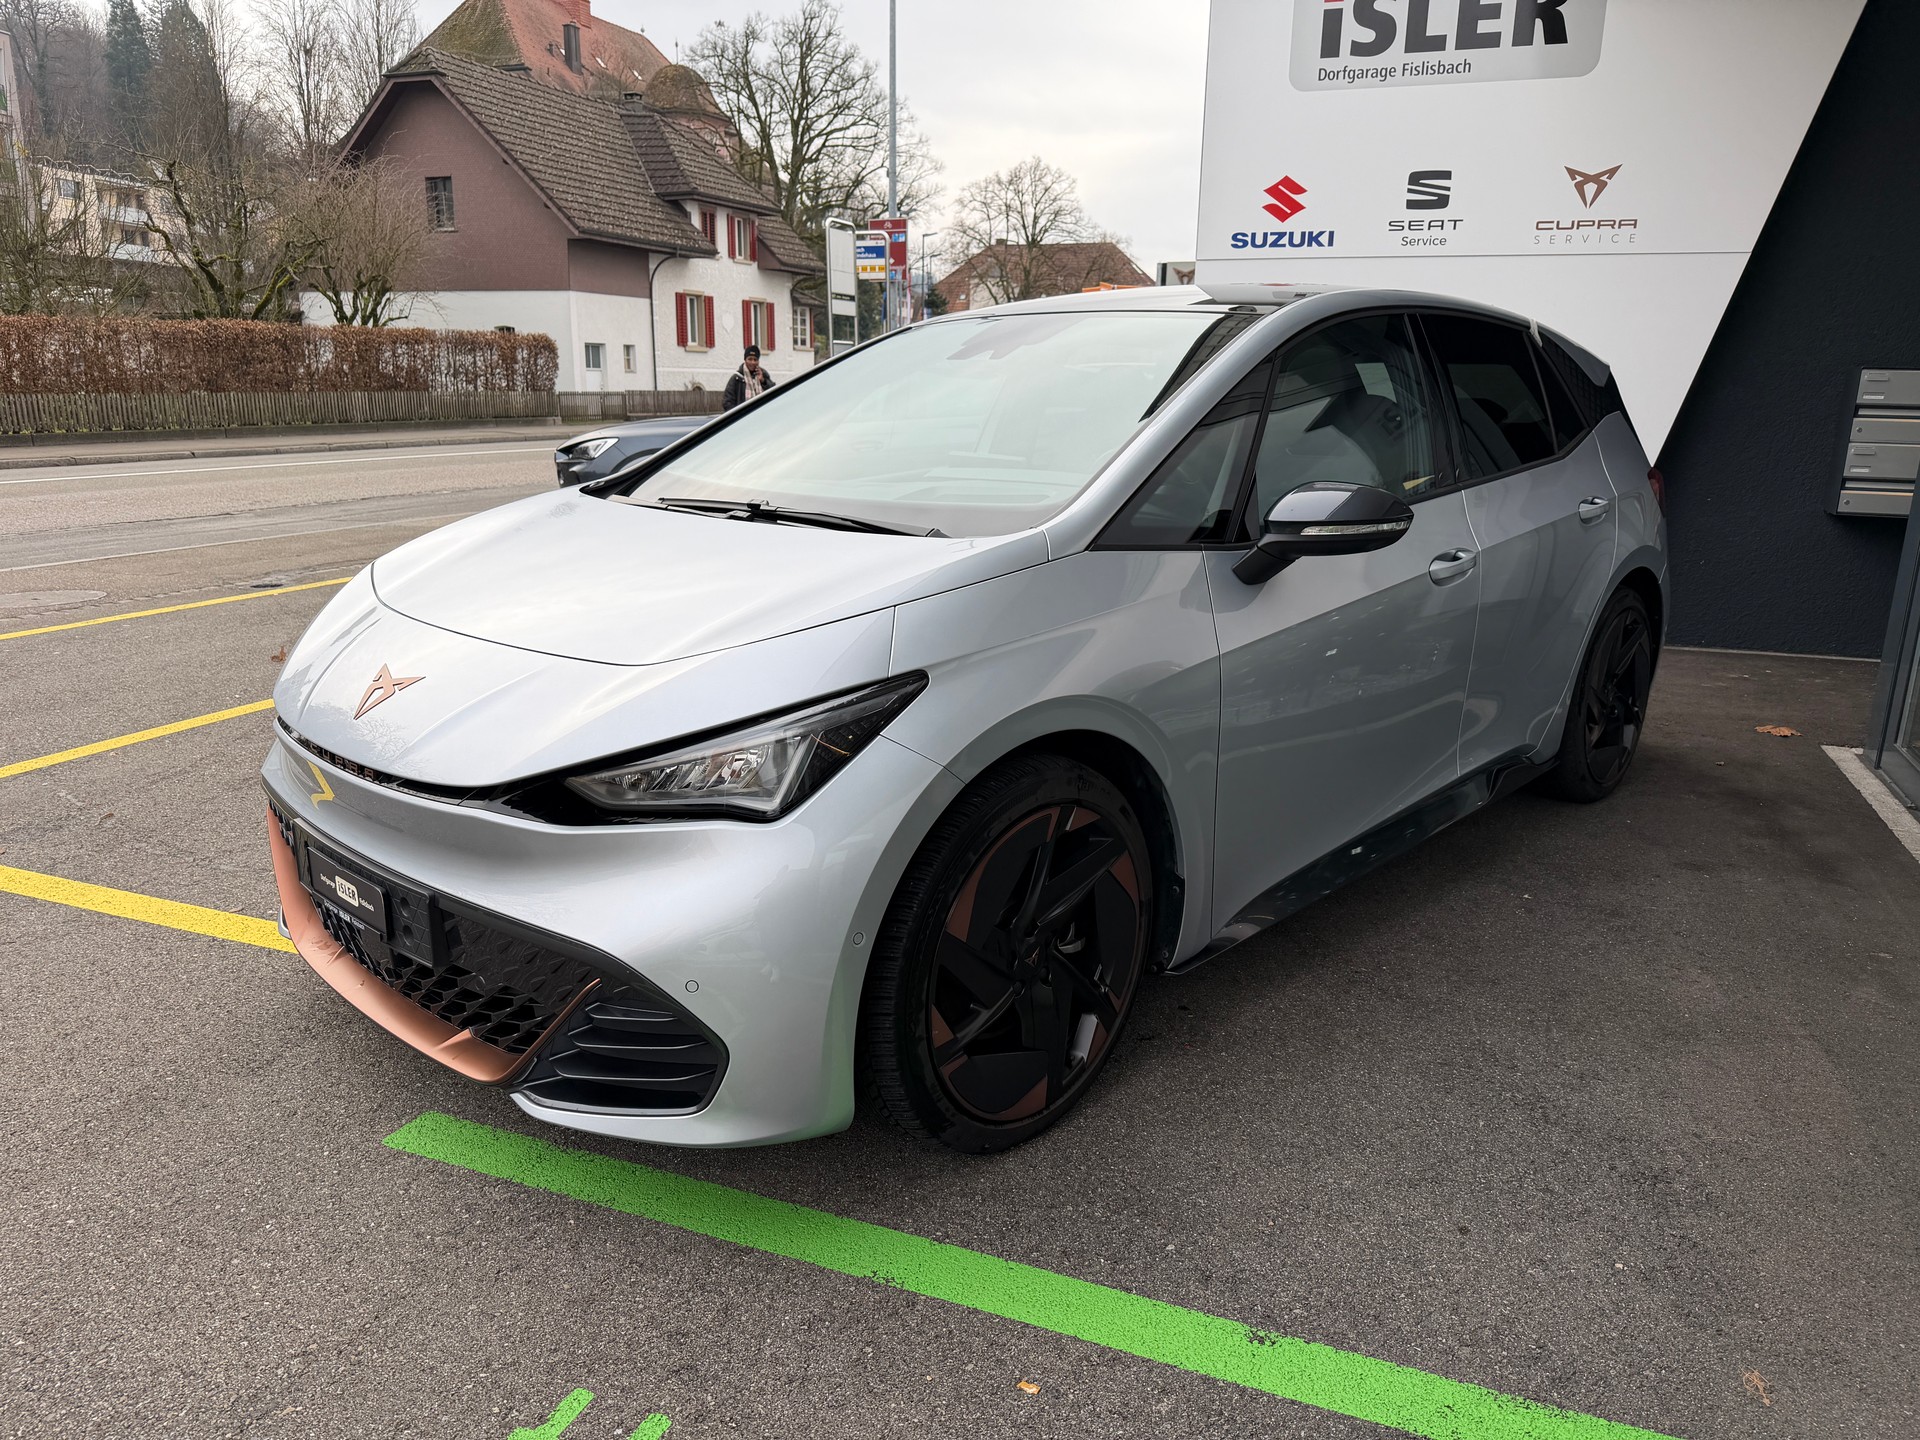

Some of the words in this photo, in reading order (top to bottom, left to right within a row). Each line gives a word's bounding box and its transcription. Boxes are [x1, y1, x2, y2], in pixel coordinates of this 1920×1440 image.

[1317, 66, 1397, 84] Dorfgarage
[1401, 58, 1472, 78] Fislisbach
[1388, 219, 1464, 232] SEAT
[1535, 218, 1638, 231] CUPRA
[1230, 230, 1335, 249] SUZUKI
[1400, 234, 1447, 247] Service
[1533, 233, 1637, 245] SERVICE
